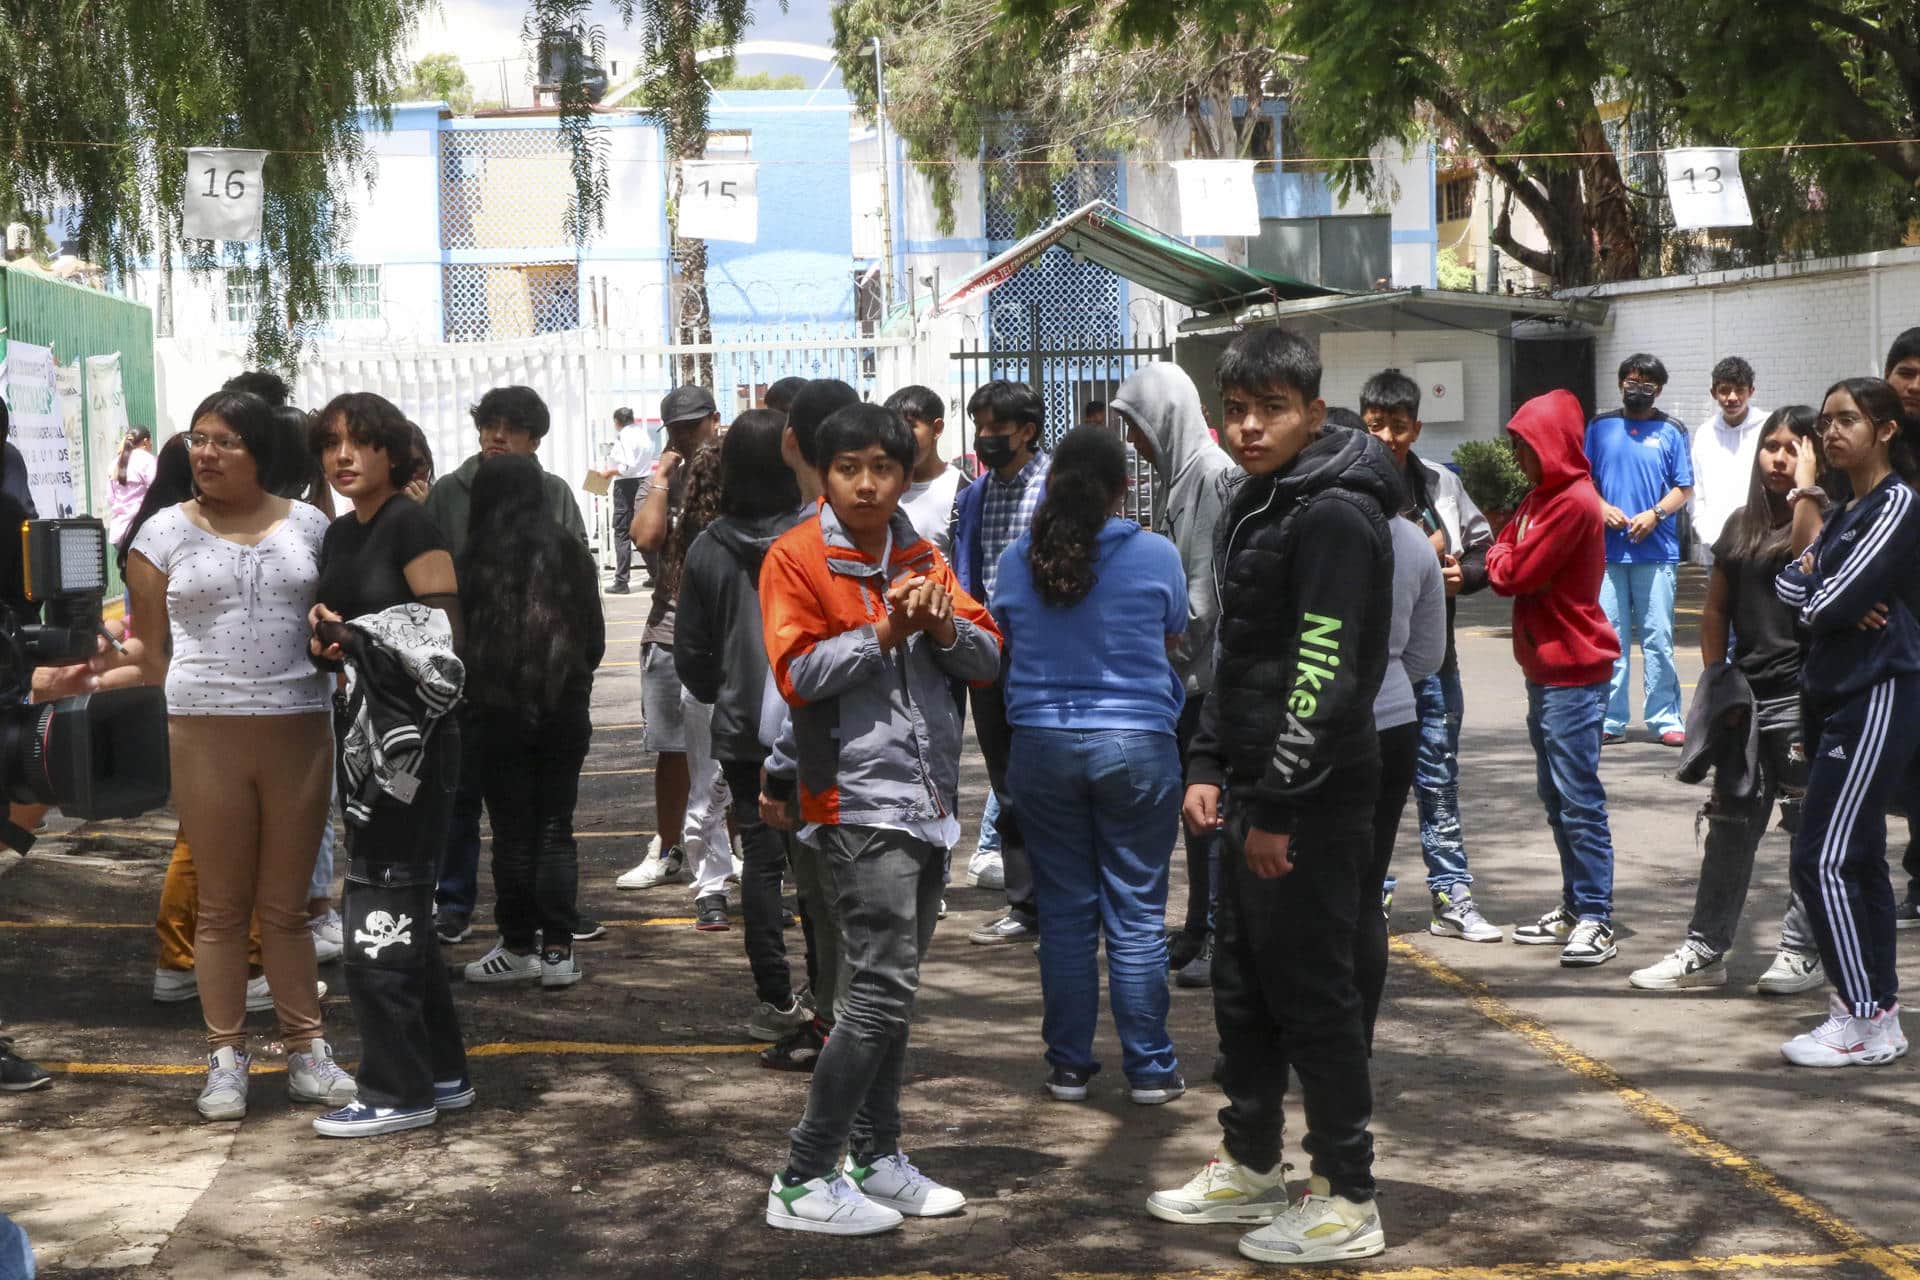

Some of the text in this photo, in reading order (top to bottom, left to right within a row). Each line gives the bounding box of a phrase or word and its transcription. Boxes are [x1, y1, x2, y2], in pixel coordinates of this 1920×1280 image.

[202, 167, 245, 199] 16
[697, 180, 737, 203] 15
[1682, 166, 1724, 194] 13
